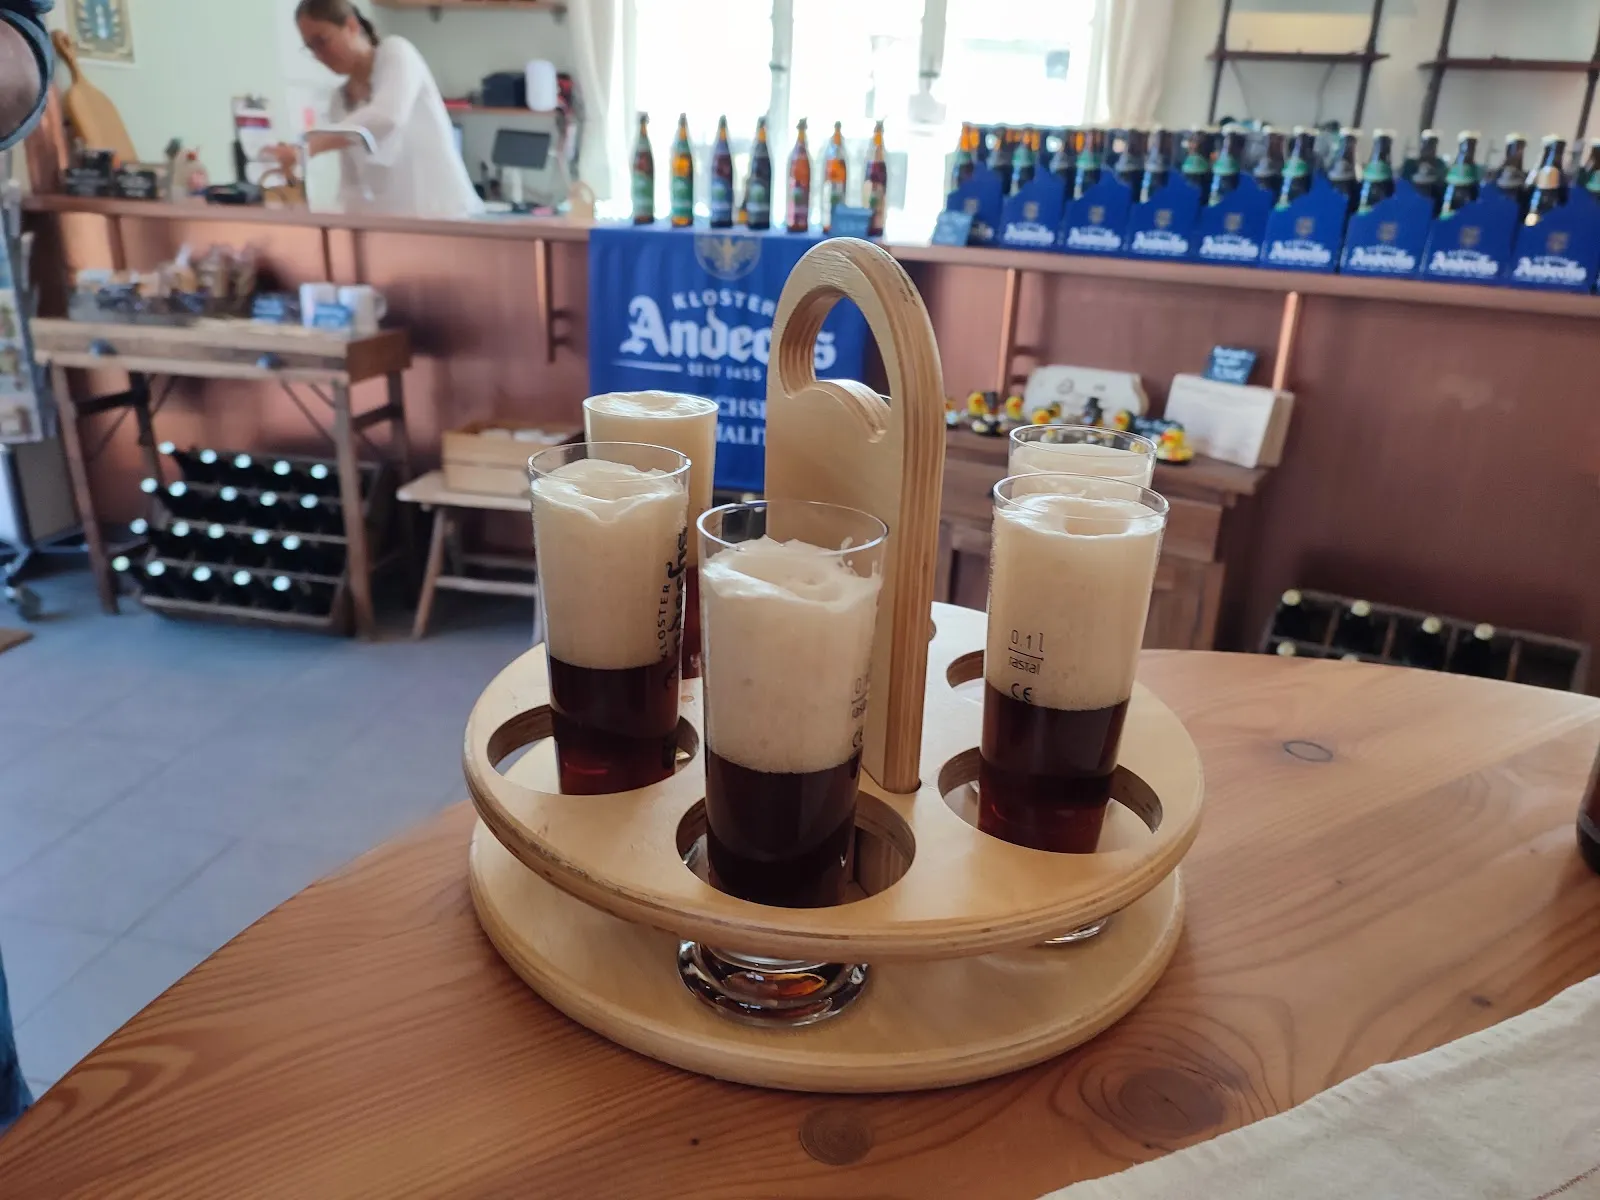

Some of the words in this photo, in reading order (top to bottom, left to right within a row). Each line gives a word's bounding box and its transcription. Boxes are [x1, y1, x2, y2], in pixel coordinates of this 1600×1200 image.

[672, 288, 776, 316] KLOSTER
[619, 295, 837, 370] Andecs
[687, 362, 721, 379] SEIT
